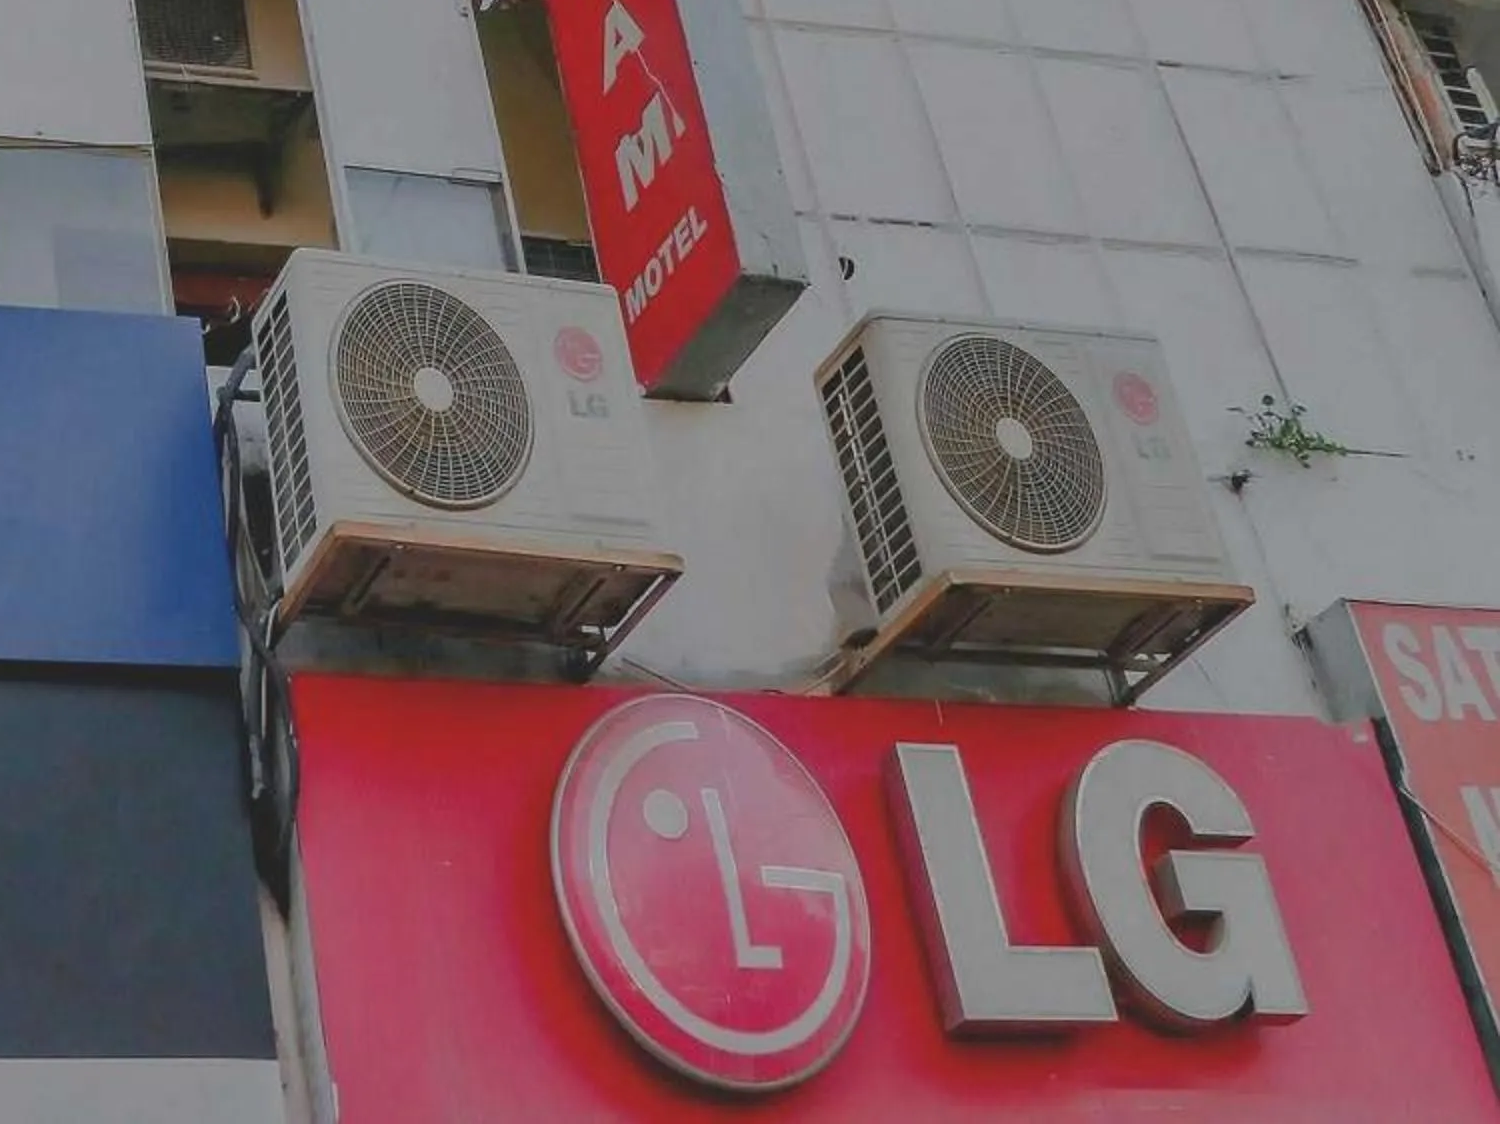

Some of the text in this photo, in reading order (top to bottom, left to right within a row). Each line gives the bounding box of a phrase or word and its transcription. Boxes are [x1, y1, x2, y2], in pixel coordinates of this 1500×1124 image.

[624, 205, 709, 325] MOTEL
[566, 388, 611, 419] LG
[888, 738, 1310, 1038] LG
